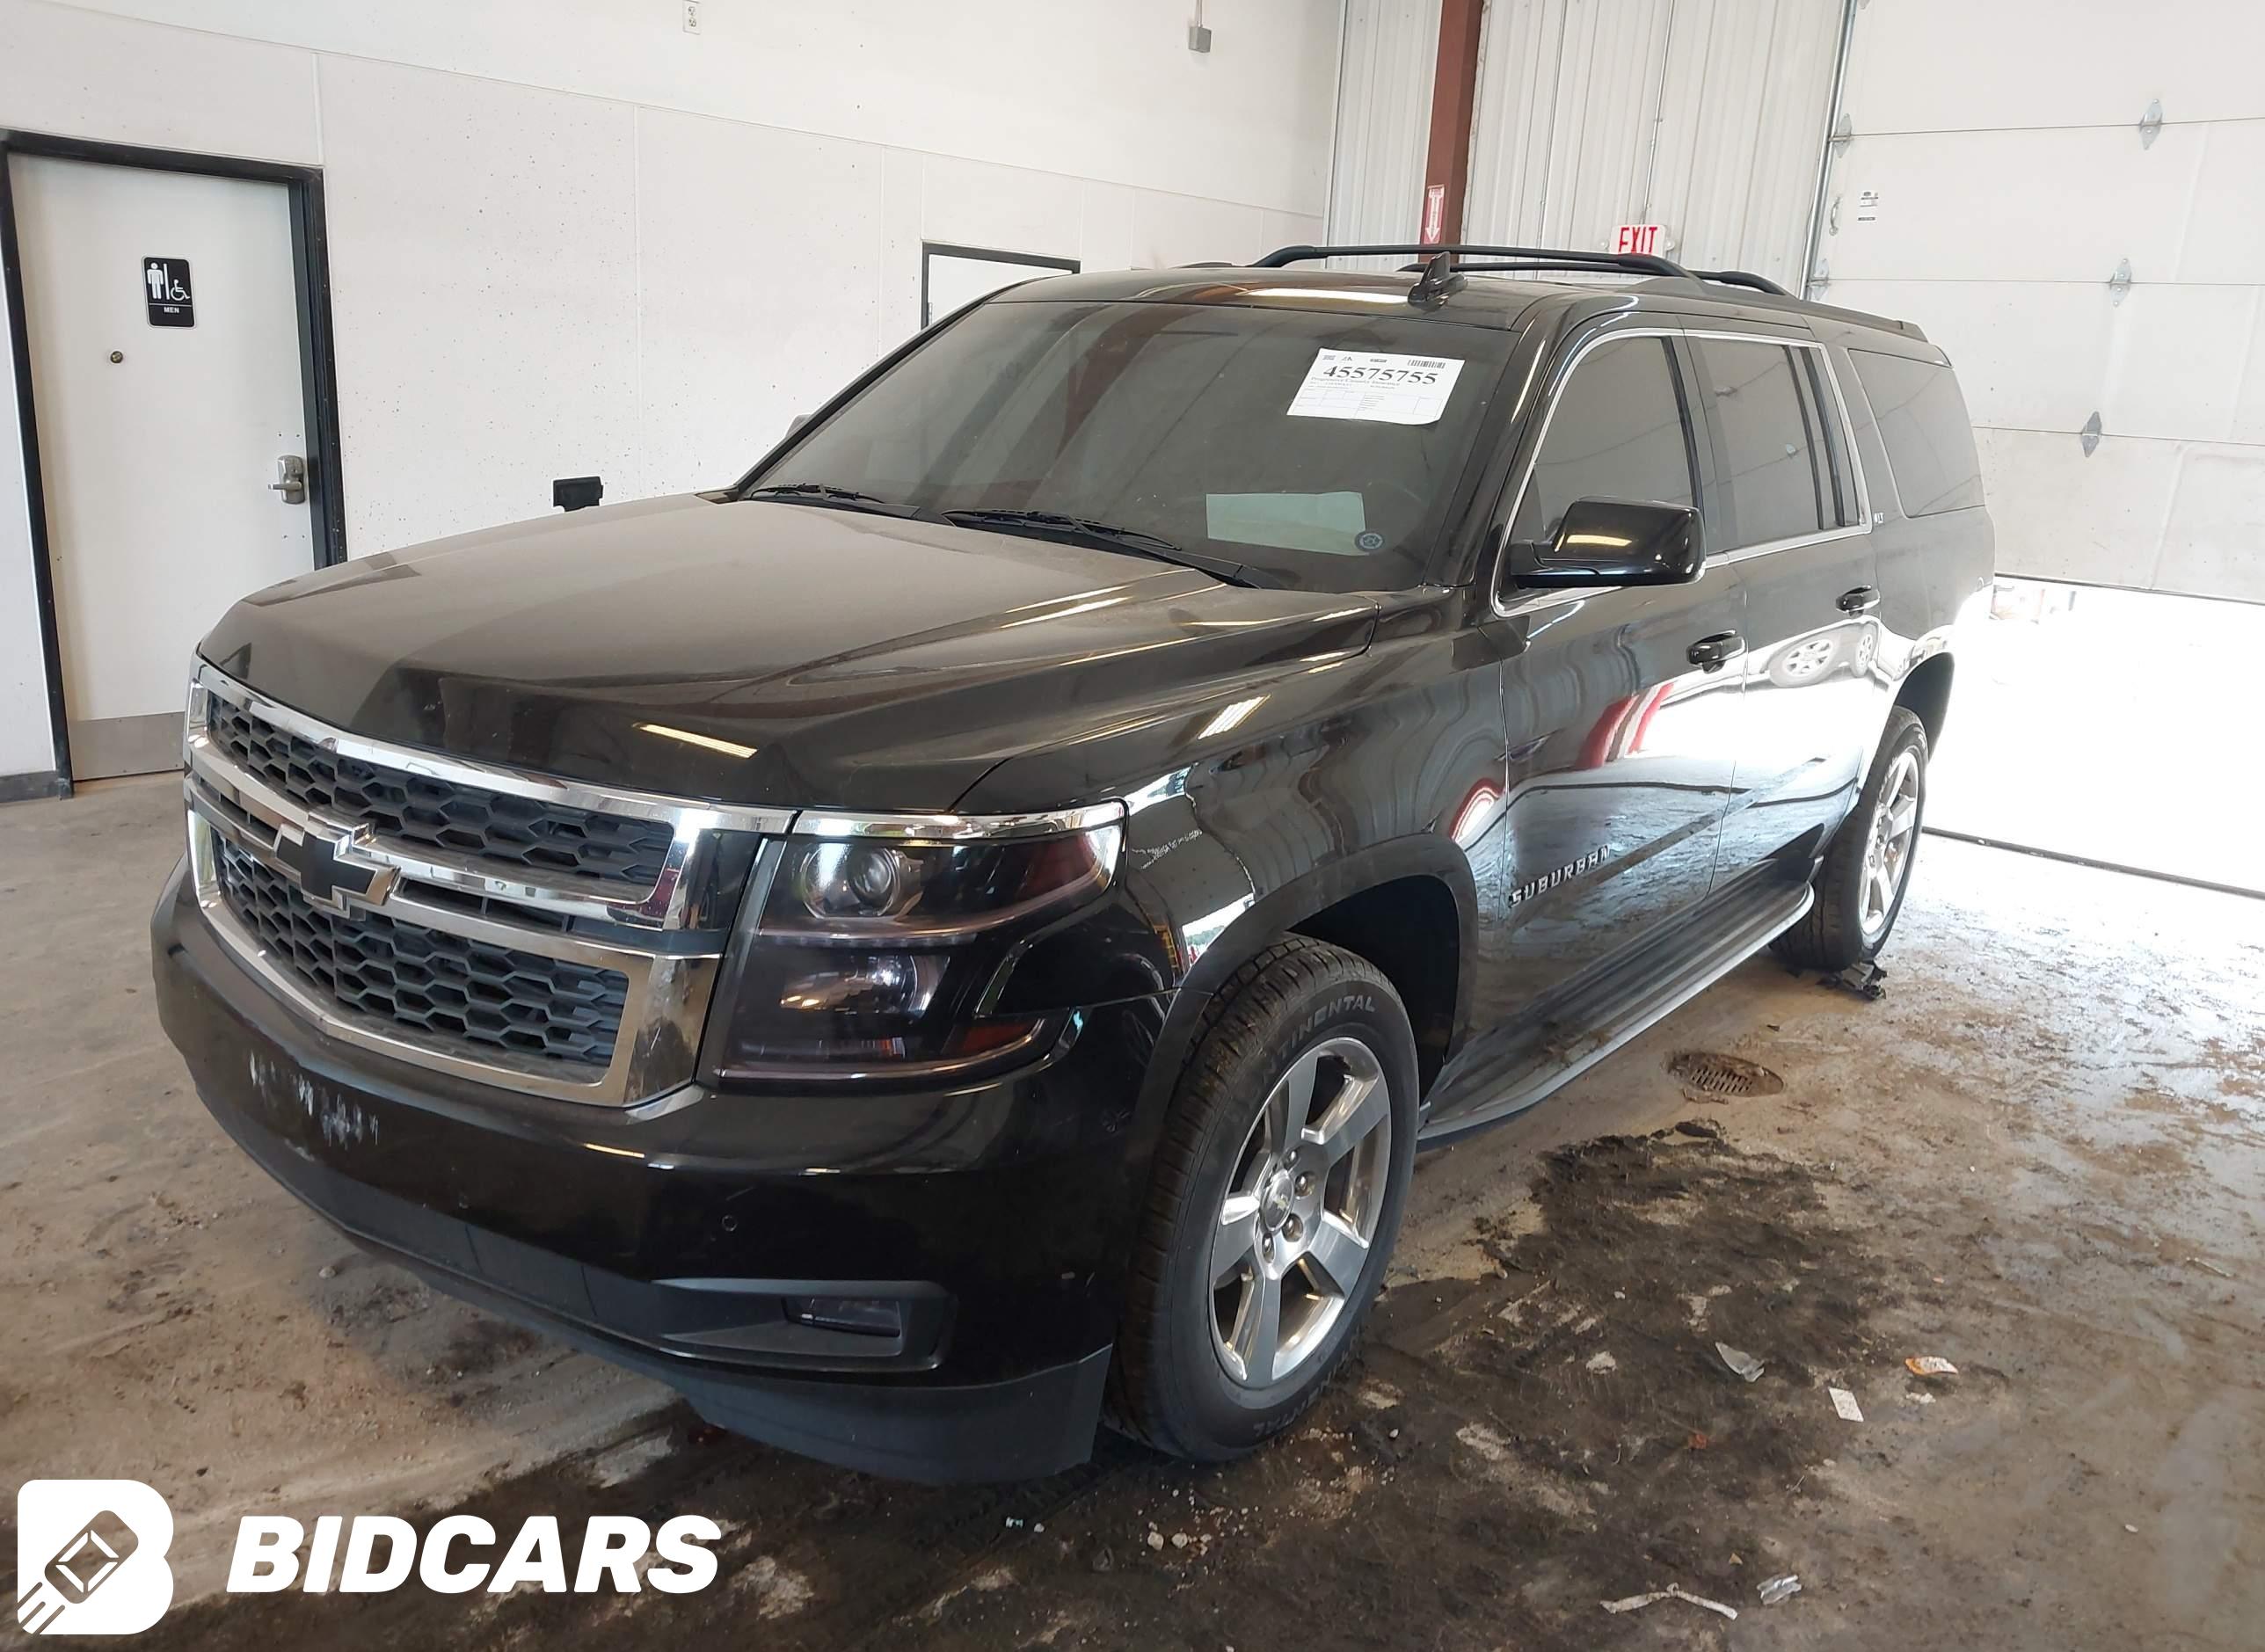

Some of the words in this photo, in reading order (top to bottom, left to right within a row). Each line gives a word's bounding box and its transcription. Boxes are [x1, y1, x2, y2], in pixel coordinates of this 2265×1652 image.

[1618, 225, 1658, 255] EXIT
[1322, 365, 1438, 385] 45575755
[1508, 845, 1610, 908] SUBURBAN
